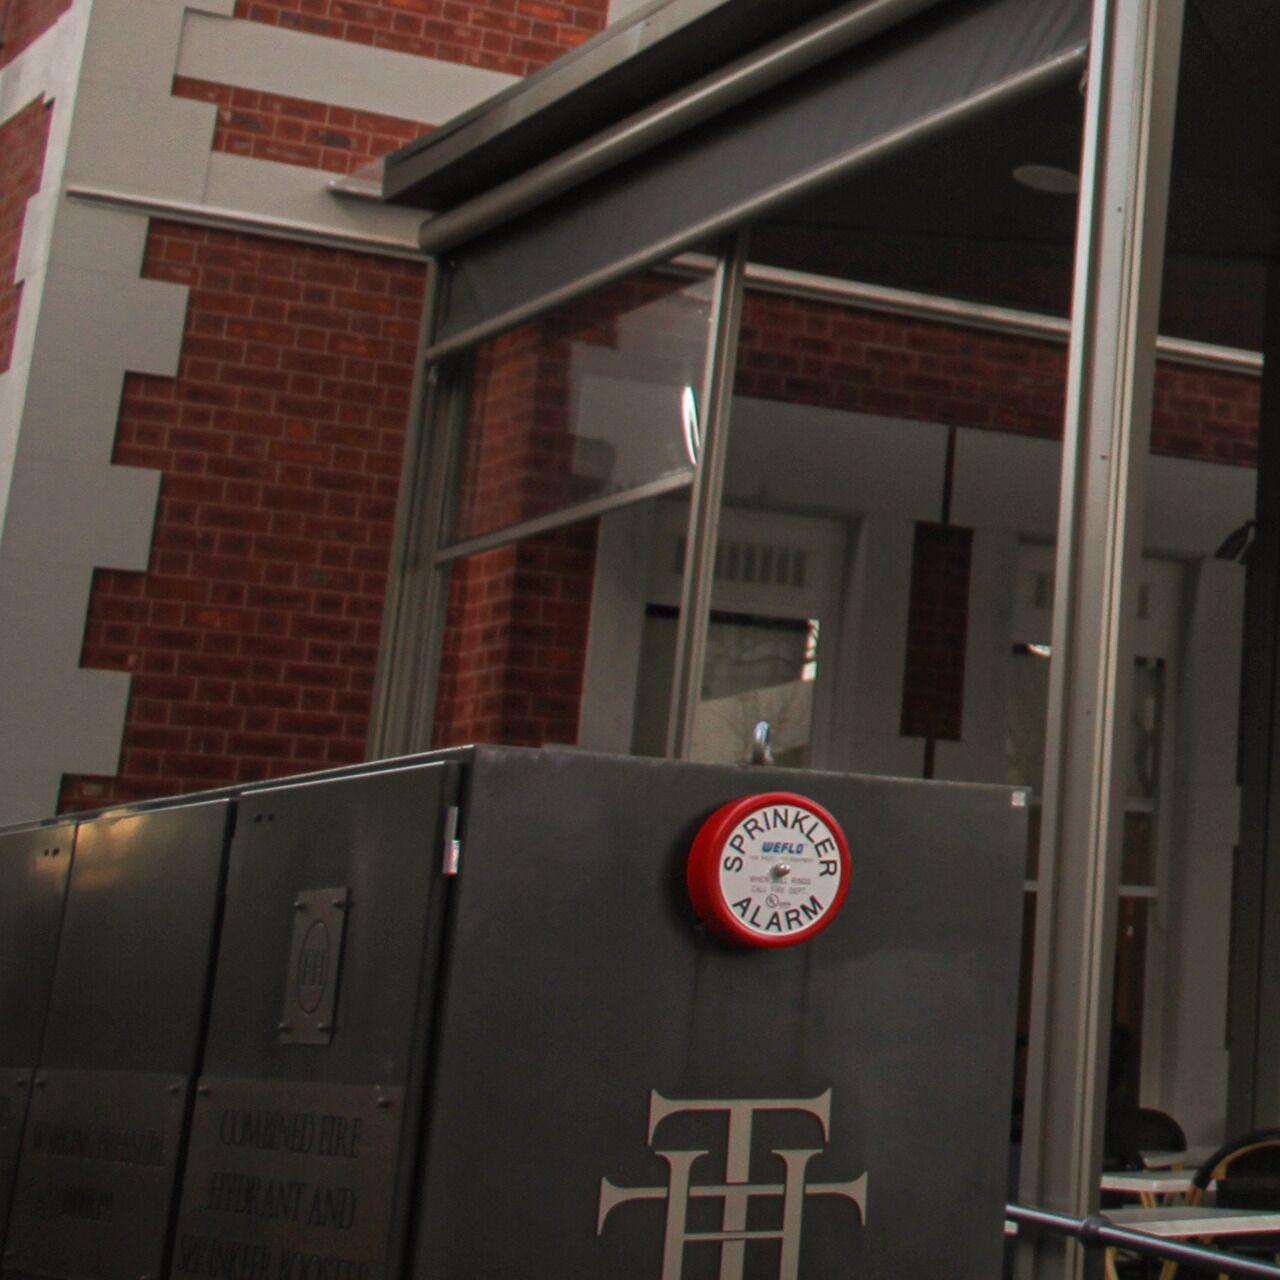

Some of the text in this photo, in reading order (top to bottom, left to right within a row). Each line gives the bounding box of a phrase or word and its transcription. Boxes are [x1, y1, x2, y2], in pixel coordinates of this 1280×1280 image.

[724, 808, 838, 877] SPRINKLER
[762, 841, 804, 854] WEFLO
[732, 895, 824, 932] ALARM
[220, 1109, 363, 1159] COMBINED FIRE
[205, 1172, 356, 1230] HYDRANT AND
